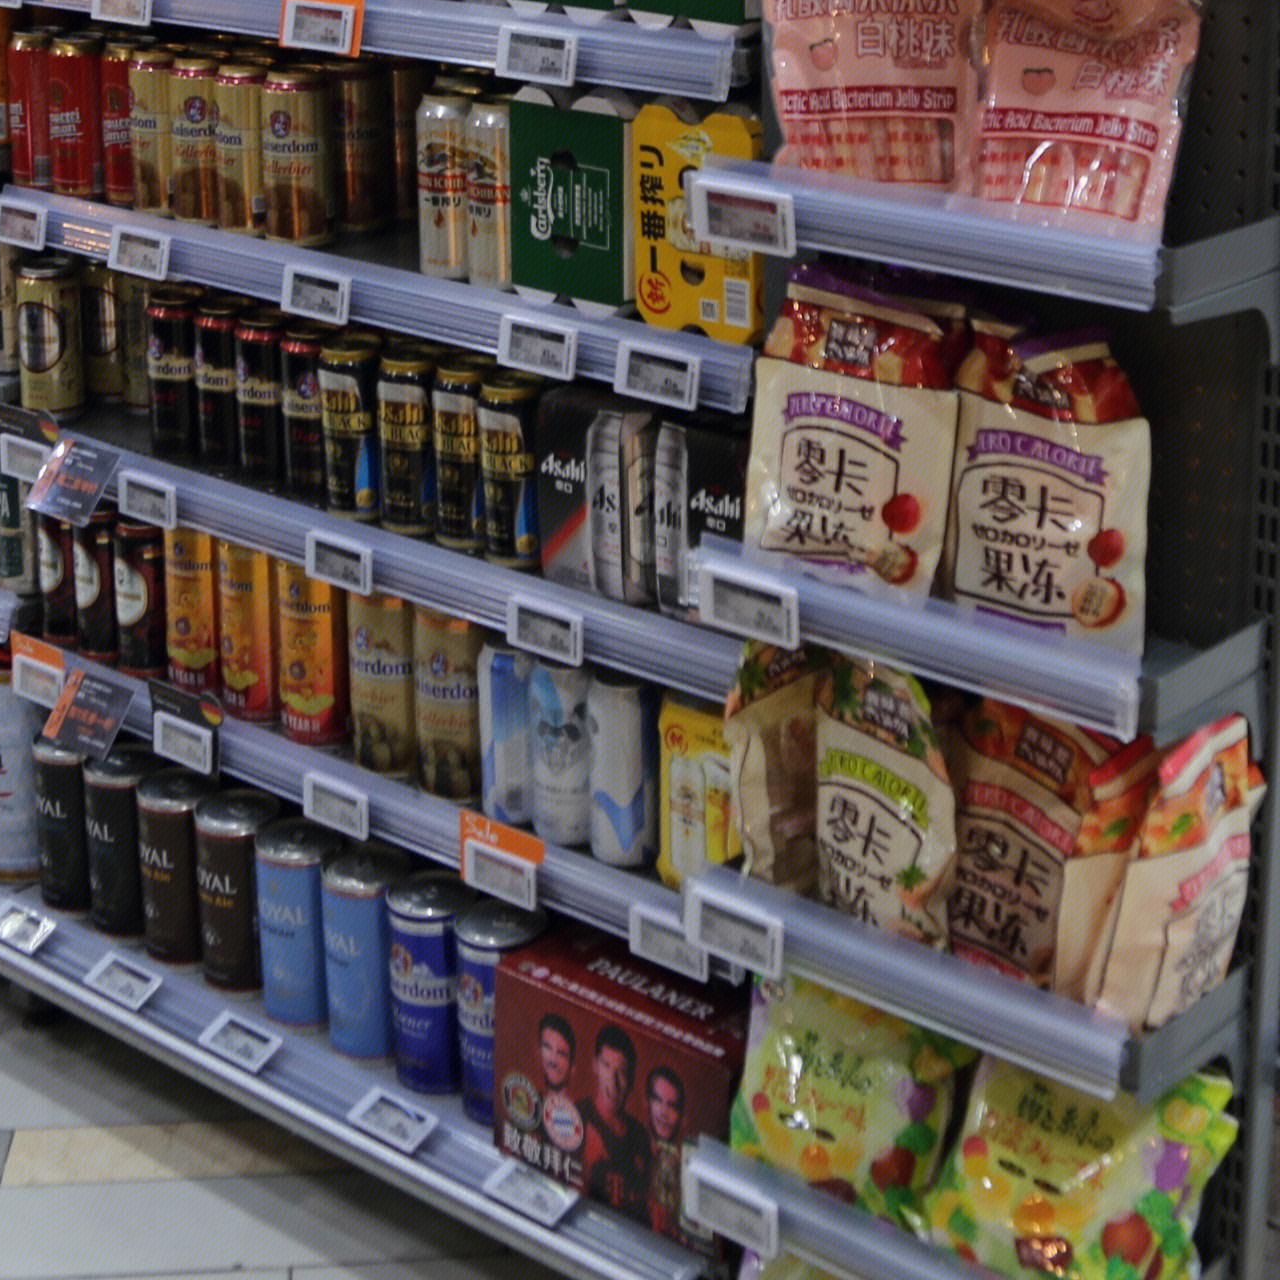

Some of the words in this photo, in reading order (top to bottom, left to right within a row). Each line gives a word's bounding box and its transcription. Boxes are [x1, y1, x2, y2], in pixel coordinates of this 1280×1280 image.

[856, 18, 957, 59] 白桃味
[782, 91, 808, 111] actic
[809, 90, 831, 111] Acid
[832, 89, 893, 111] Bacterium
[895, 87, 921, 112] Jelly
[923, 88, 955, 112] Strip
[1075, 61, 1170, 96] 白桃味
[1004, 111, 1029, 131] Acid
[1031, 111, 1093, 135] Bacterium
[1096, 115, 1125, 140] Jelly
[530, 156, 554, 242] Carlsberg
[639, 143, 666, 273] 一番搾り
[541, 453, 585, 483] Asahi
[795, 438, 869, 497] 零卡
[690, 489, 741, 520] Asahi
[979, 474, 1076, 532] 零卡
[981, 546, 1066, 605] 果冻
[828, 793, 893, 867] 零卡
[966, 825, 1050, 897] 零卡
[955, 887, 1027, 956] 果冻
[587, 958, 715, 1020] PAULANER
